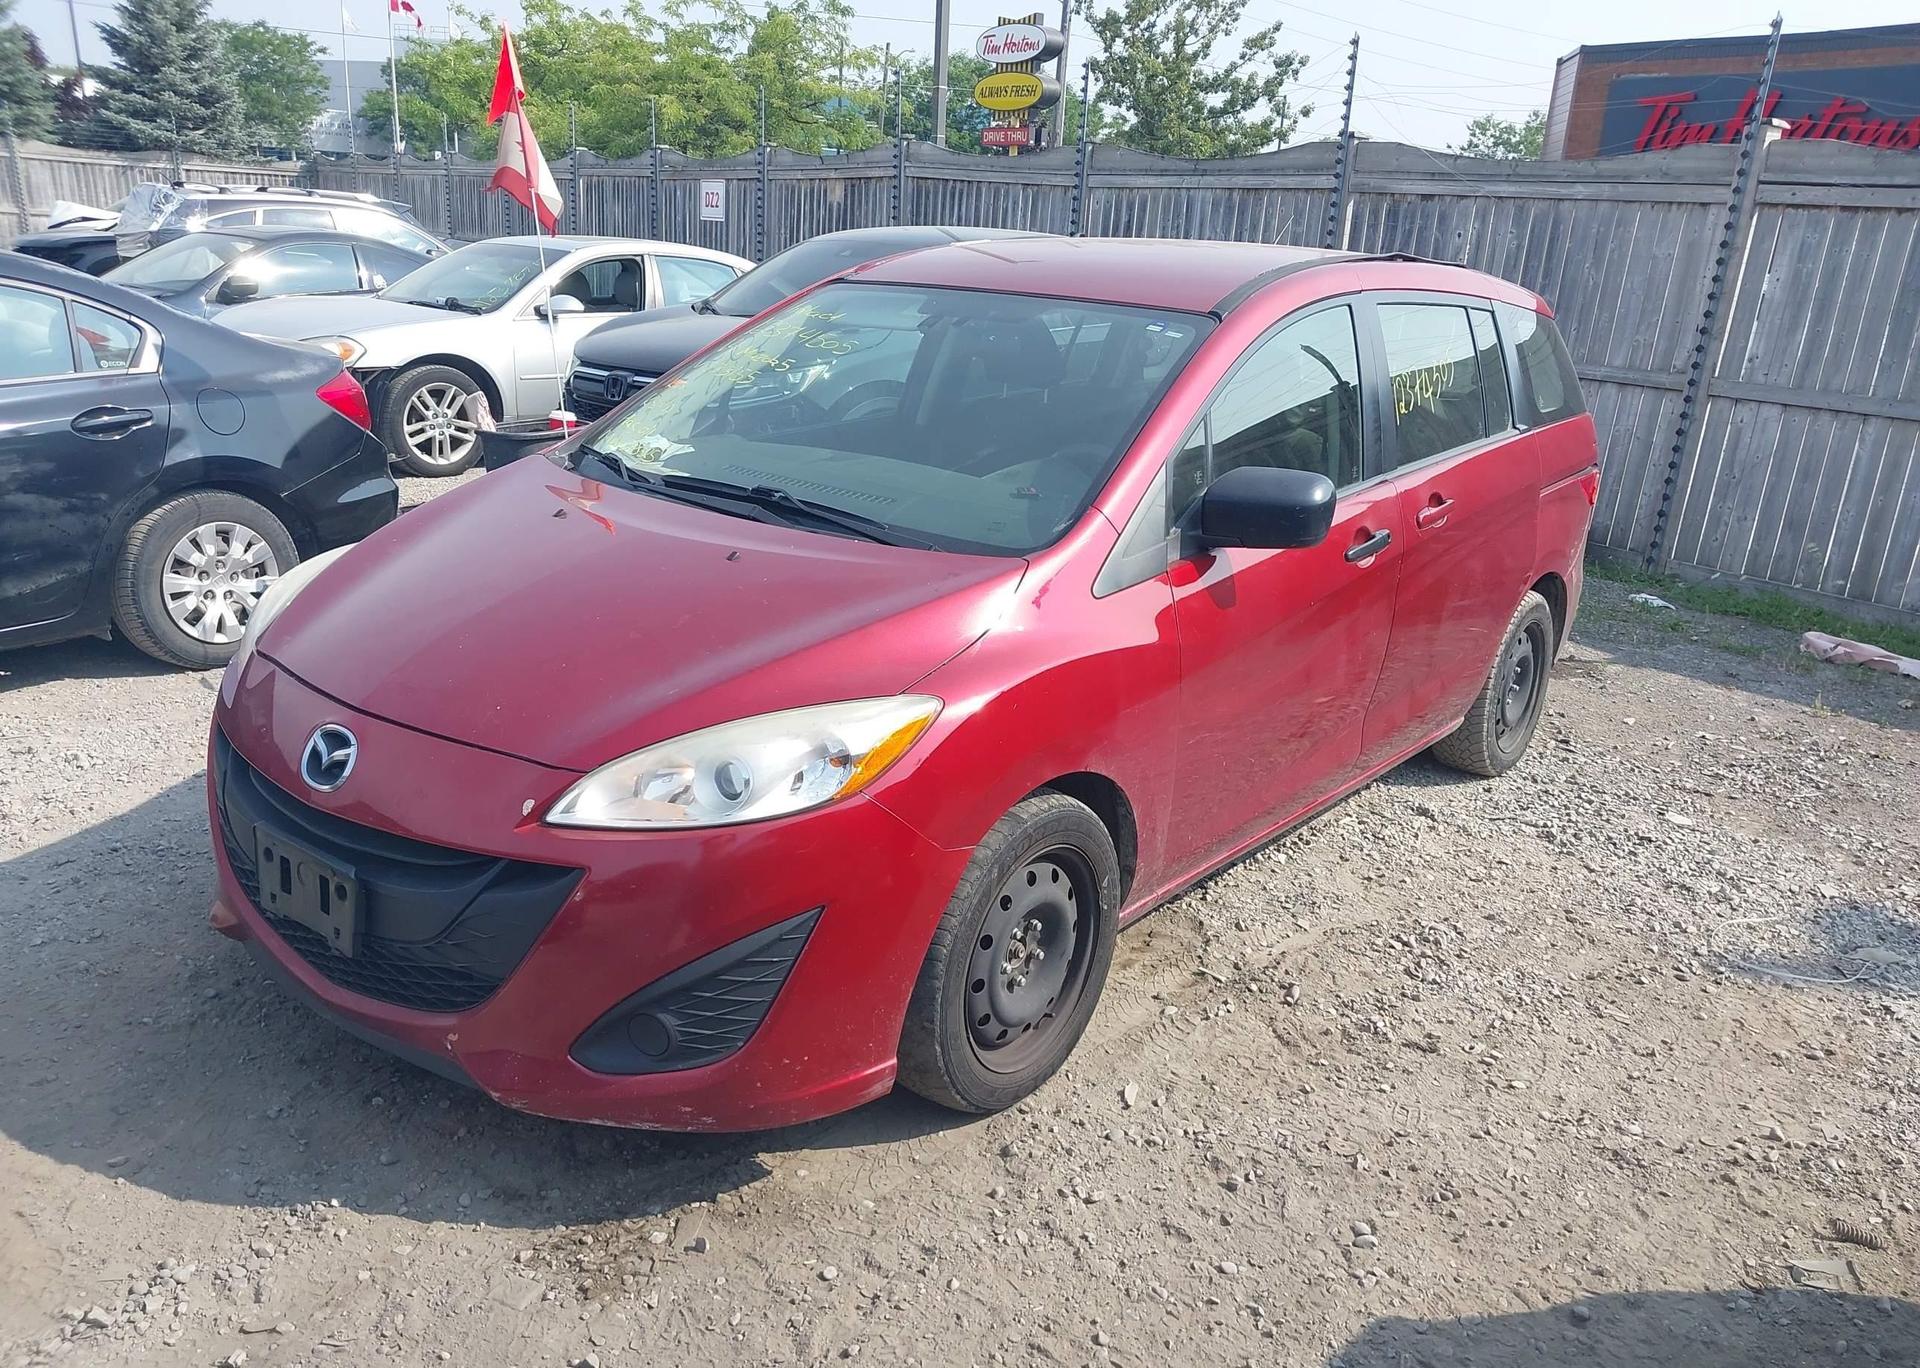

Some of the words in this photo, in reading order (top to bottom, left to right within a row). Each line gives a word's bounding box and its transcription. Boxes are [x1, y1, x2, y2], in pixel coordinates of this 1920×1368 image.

[982, 34, 1001, 56] Tim
[1002, 32, 1040, 54] Hortons
[978, 86, 1009, 98] ALWAYS
[1009, 84, 1038, 97] FRESH
[1634, 91, 1716, 152] Tim
[1722, 87, 1920, 150] Hrtons
[983, 130, 1005, 142] DRIVE
[1006, 130, 1028, 142] THRU
[705, 191, 720, 208] DZ2
